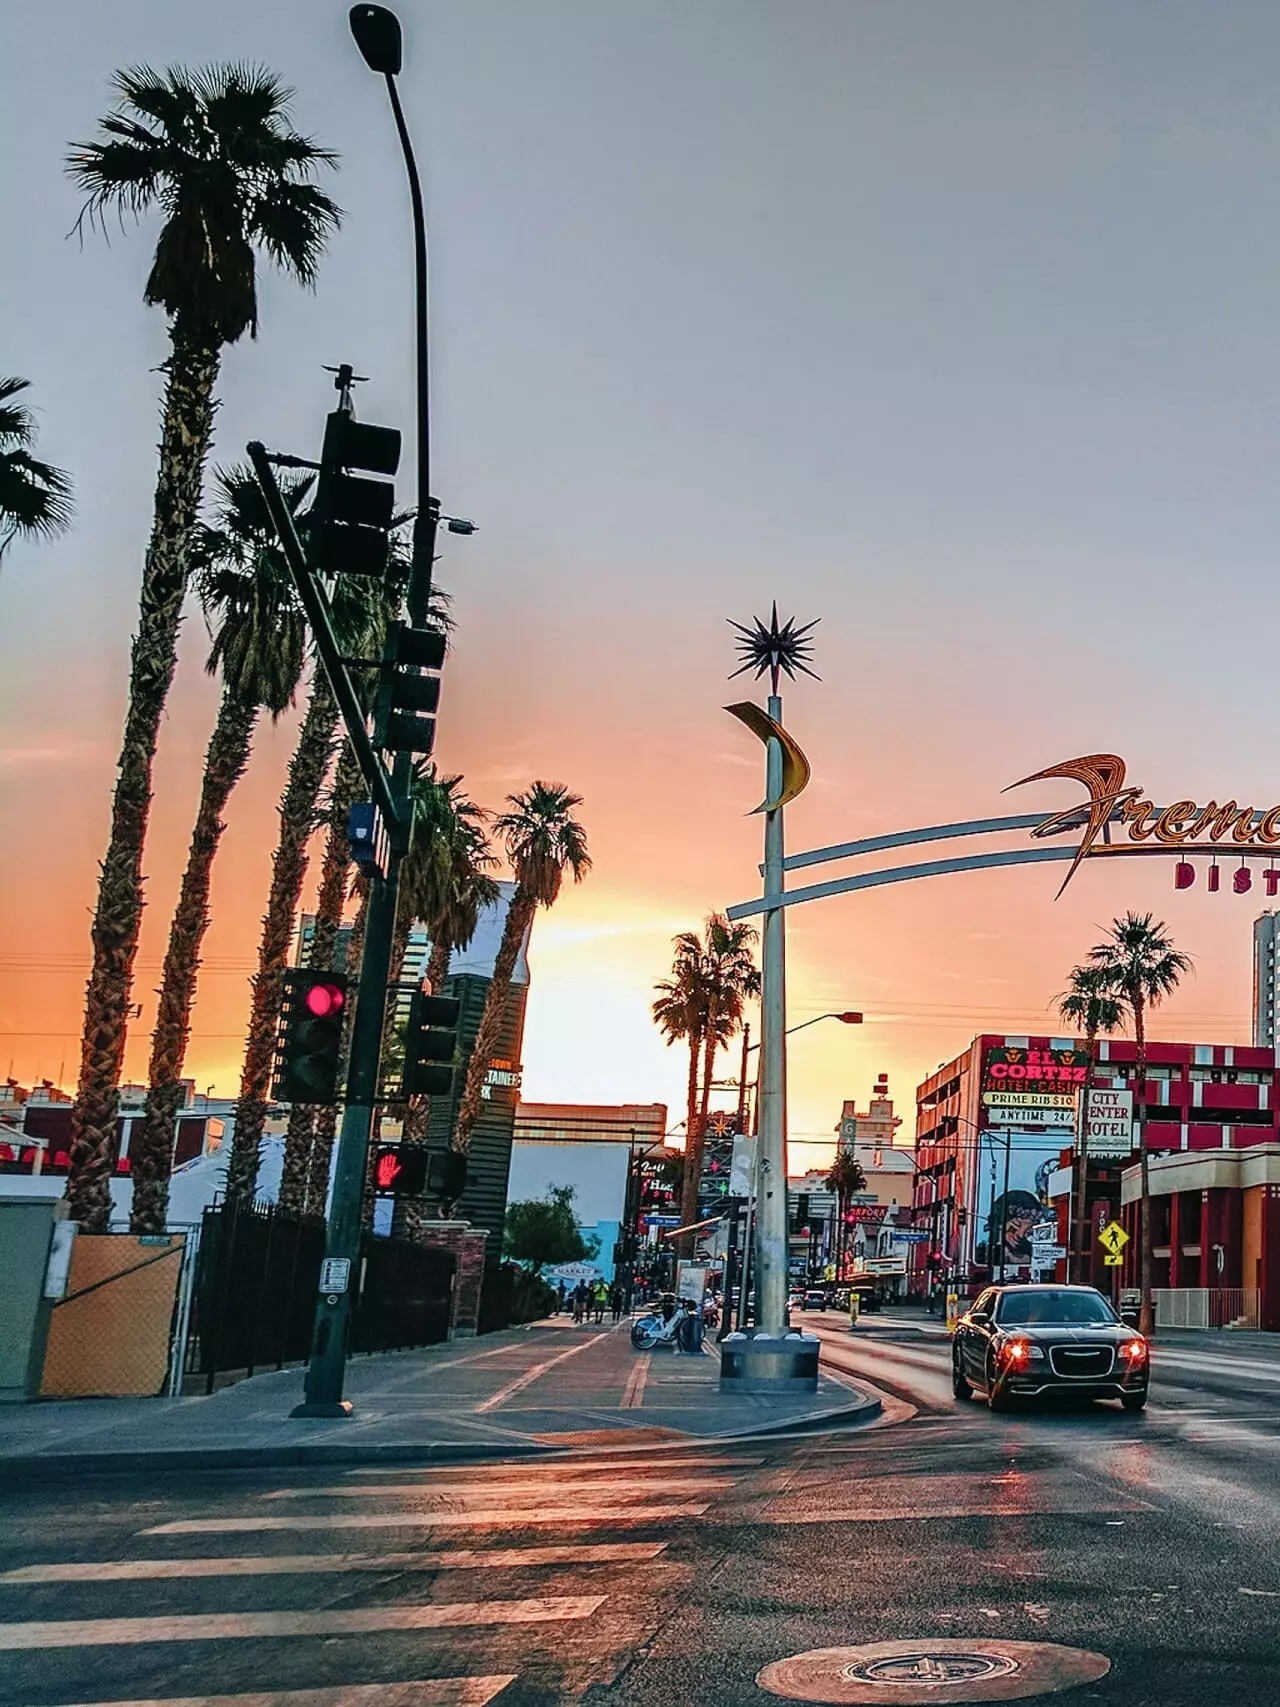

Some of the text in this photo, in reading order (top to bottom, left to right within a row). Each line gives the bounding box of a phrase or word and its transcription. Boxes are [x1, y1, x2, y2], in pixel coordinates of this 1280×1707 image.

[1026, 1051, 1056, 1065] EL
[487, 1069, 521, 1087] TAINER
[989, 1063, 1088, 1082] CORTEZ
[991, 1093, 1029, 1105] PRIME
[1031, 1095, 1051, 1106] RIB
[1092, 1093, 1119, 1106] CITY
[999, 1109, 1045, 1122] ANYTIME
[1088, 1106, 1128, 1119] ENTER
